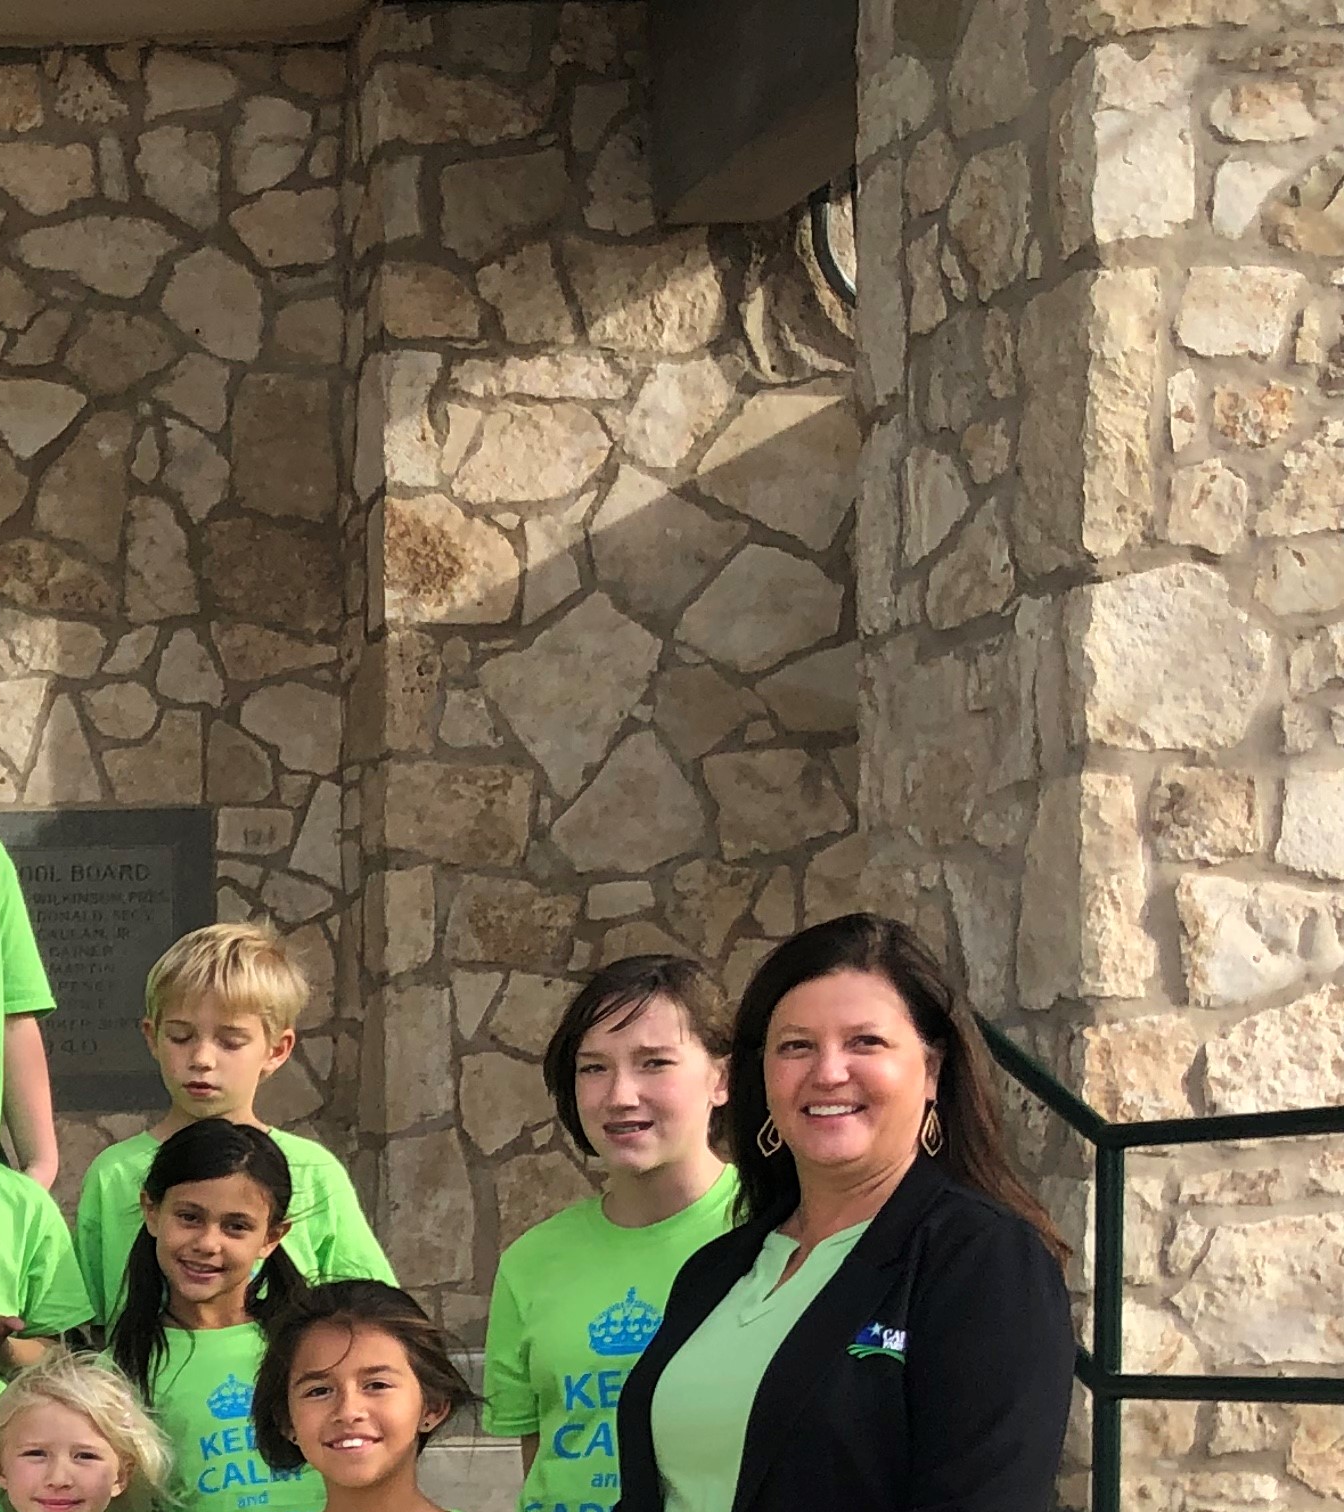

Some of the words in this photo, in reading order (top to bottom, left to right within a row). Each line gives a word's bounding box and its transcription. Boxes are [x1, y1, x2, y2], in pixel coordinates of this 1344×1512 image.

[70, 863, 151, 882] BOARD
[552, 1423, 615, 1460] CA
[591, 1471, 620, 1488] an
[237, 1490, 269, 1509] and
